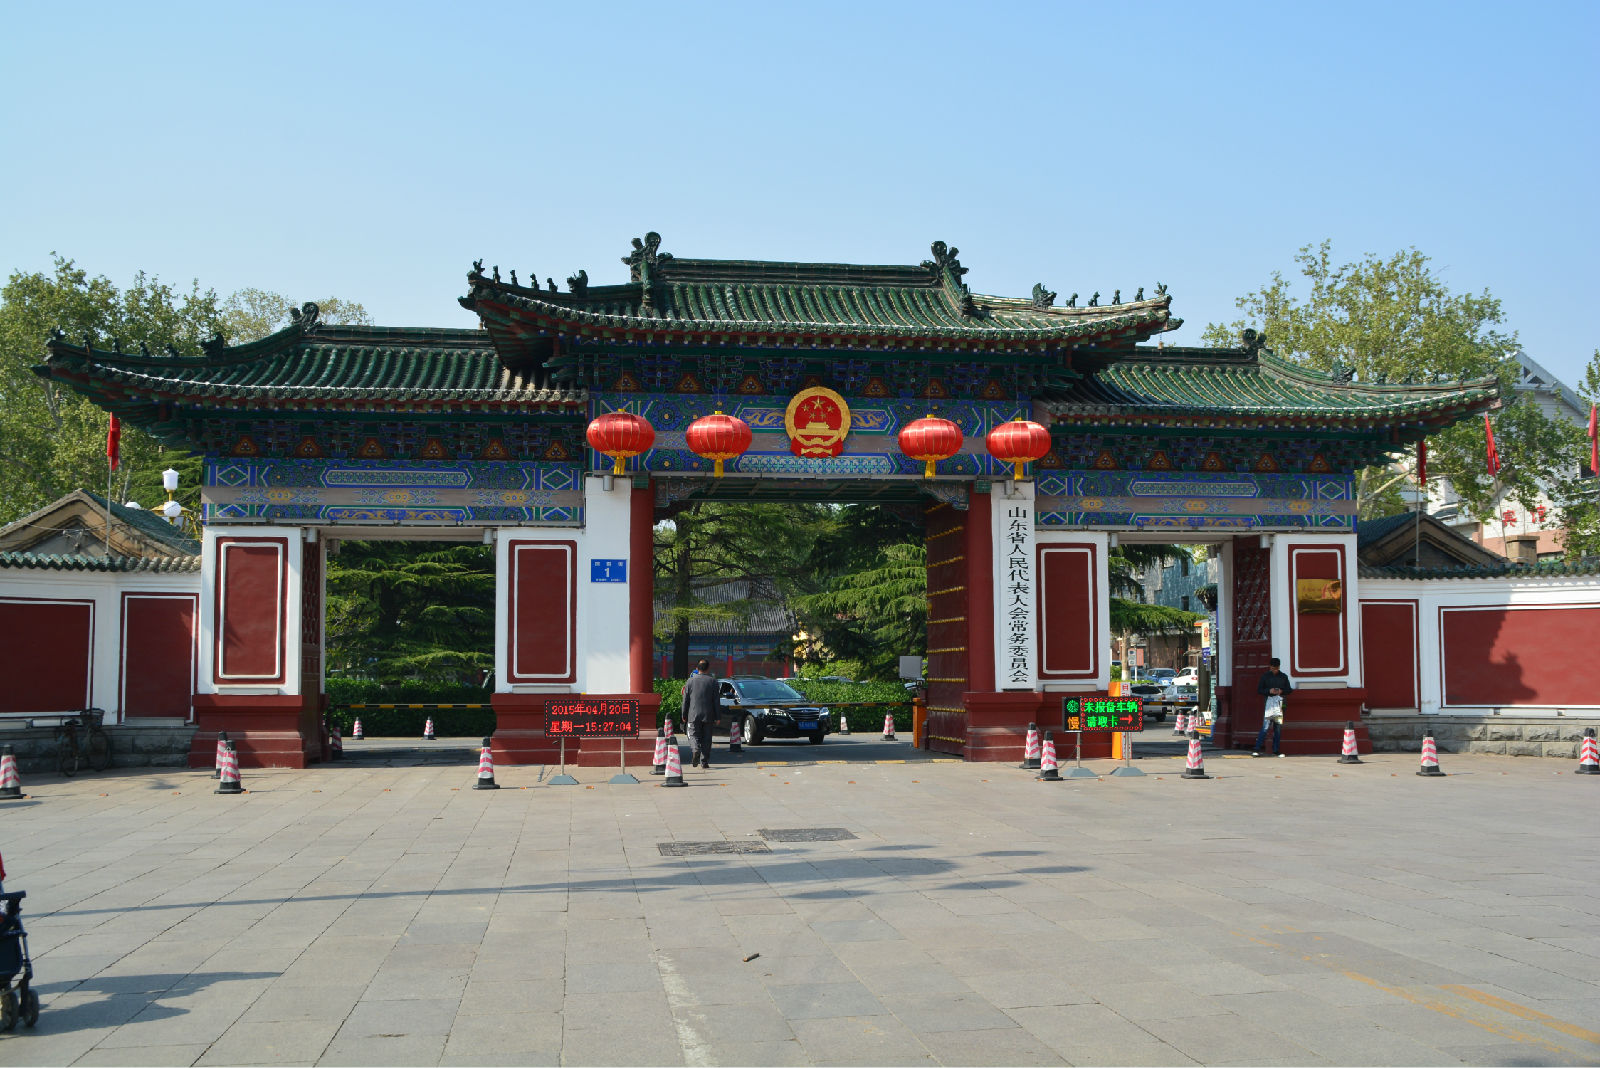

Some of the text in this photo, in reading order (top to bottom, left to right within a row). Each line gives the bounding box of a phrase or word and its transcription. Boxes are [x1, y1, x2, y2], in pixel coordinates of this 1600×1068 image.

[1502, 504, 1546, 527] 宾馆
[604, 567, 610, 578] 1
[1007, 506, 1030, 683] 山东省人民代表大会常务委员会
[551, 703, 630, 716] 2015年04月20日
[1084, 701, 1138, 713] 未报备车辆
[1067, 716, 1080, 730] 慢
[1087, 715, 1119, 728] 请取卡
